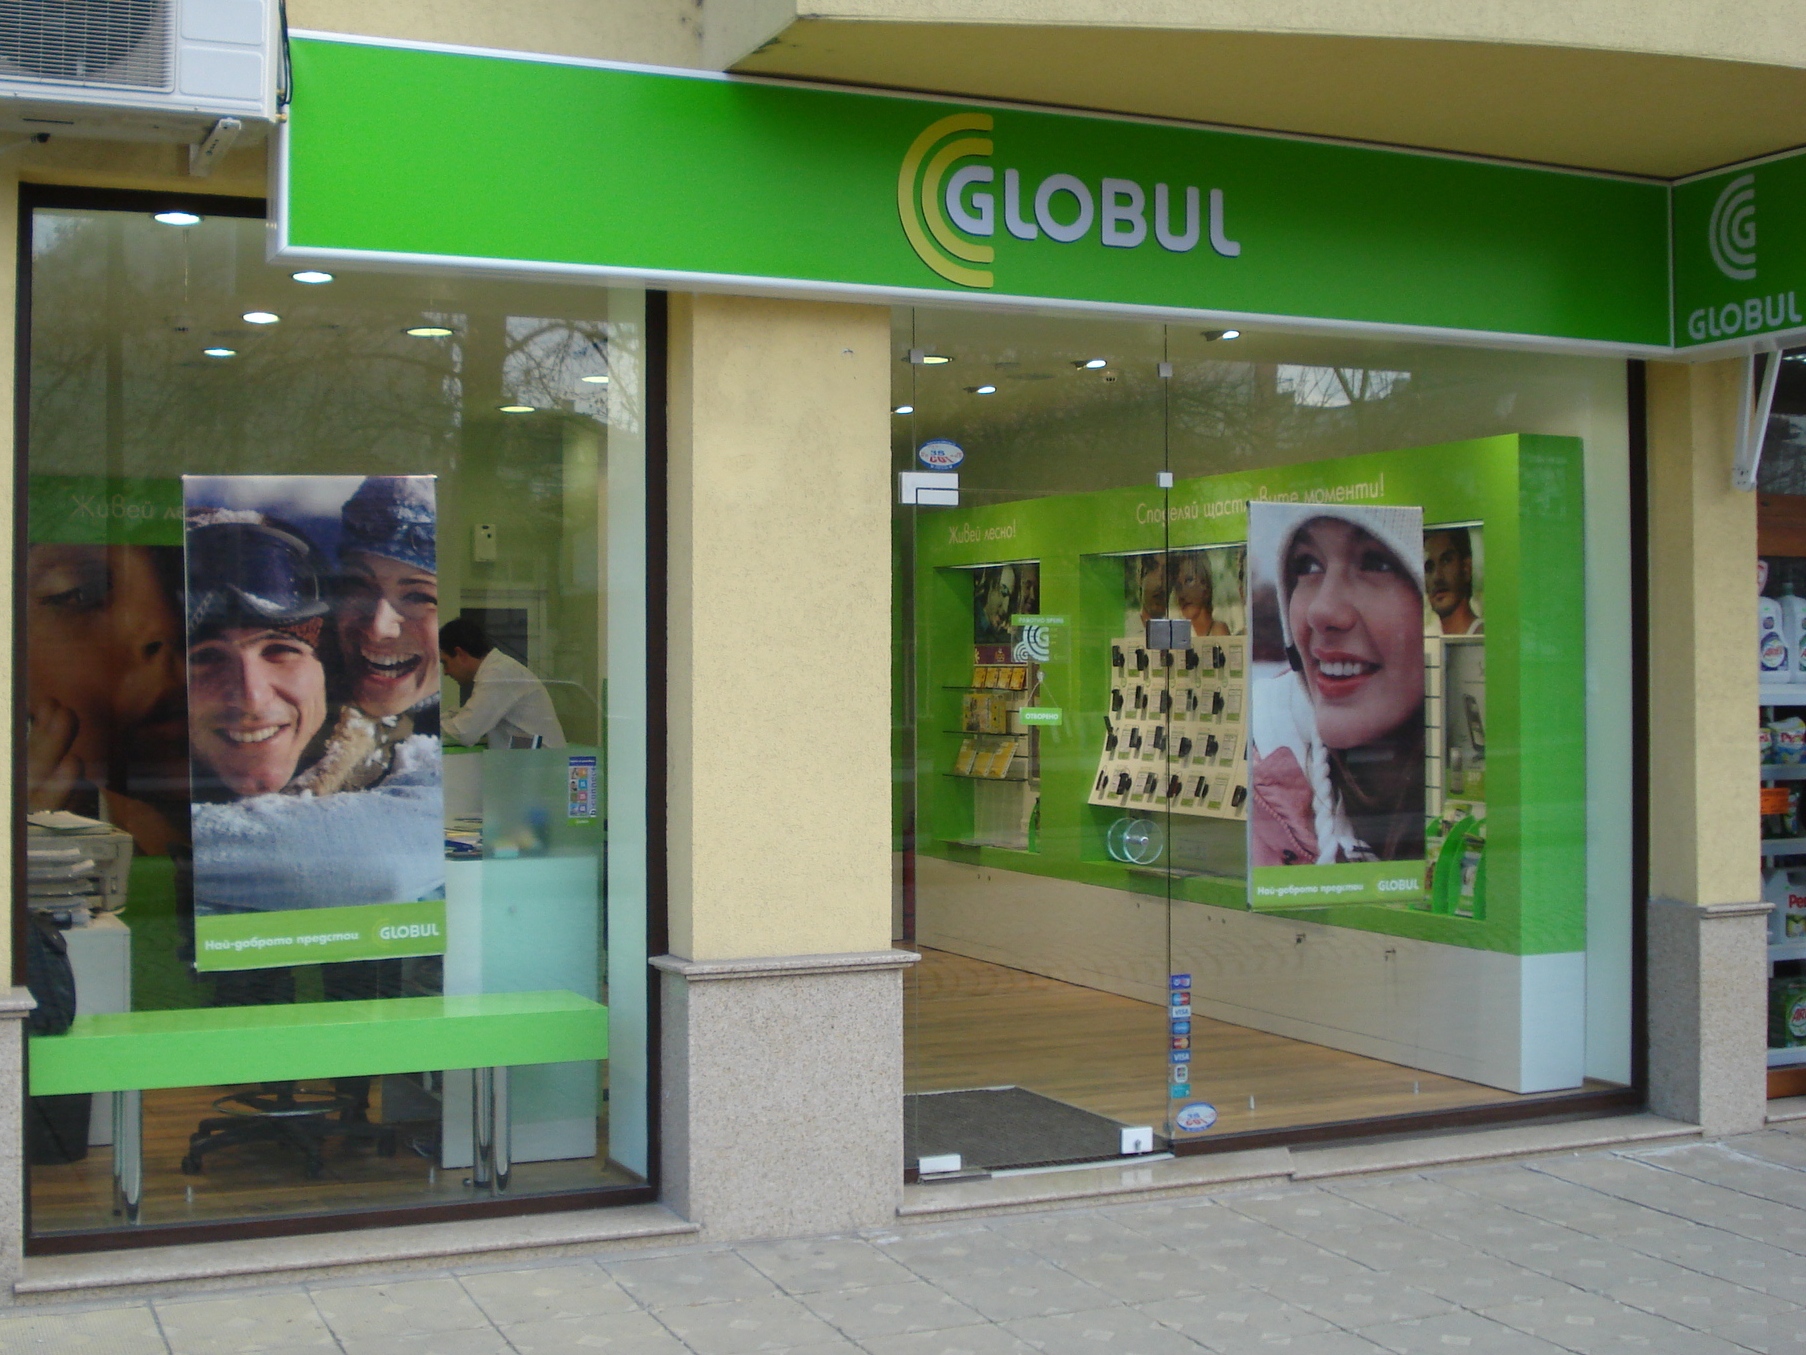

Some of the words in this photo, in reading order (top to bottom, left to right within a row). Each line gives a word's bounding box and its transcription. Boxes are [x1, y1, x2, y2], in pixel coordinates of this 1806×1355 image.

[944, 164, 1241, 258] GLOBUL
[1688, 291, 1803, 341] GLOBUL
[1303, 472, 1384, 504] моменти!
[70, 493, 155, 519] Живей
[948, 522, 981, 544] Живей
[984, 518, 1017, 541] лесно!
[1256, 884, 1319, 897] Най-доброто
[1320, 882, 1364, 895] предстои
[1377, 878, 1420, 892] GLOBUL
[205, 935, 293, 951] Най-доброто
[296, 930, 360, 946] предстои
[379, 922, 440, 940] GLOBUL
[1174, 1008, 1189, 1016] VISA
[1173, 1052, 1190, 1061] VISA
